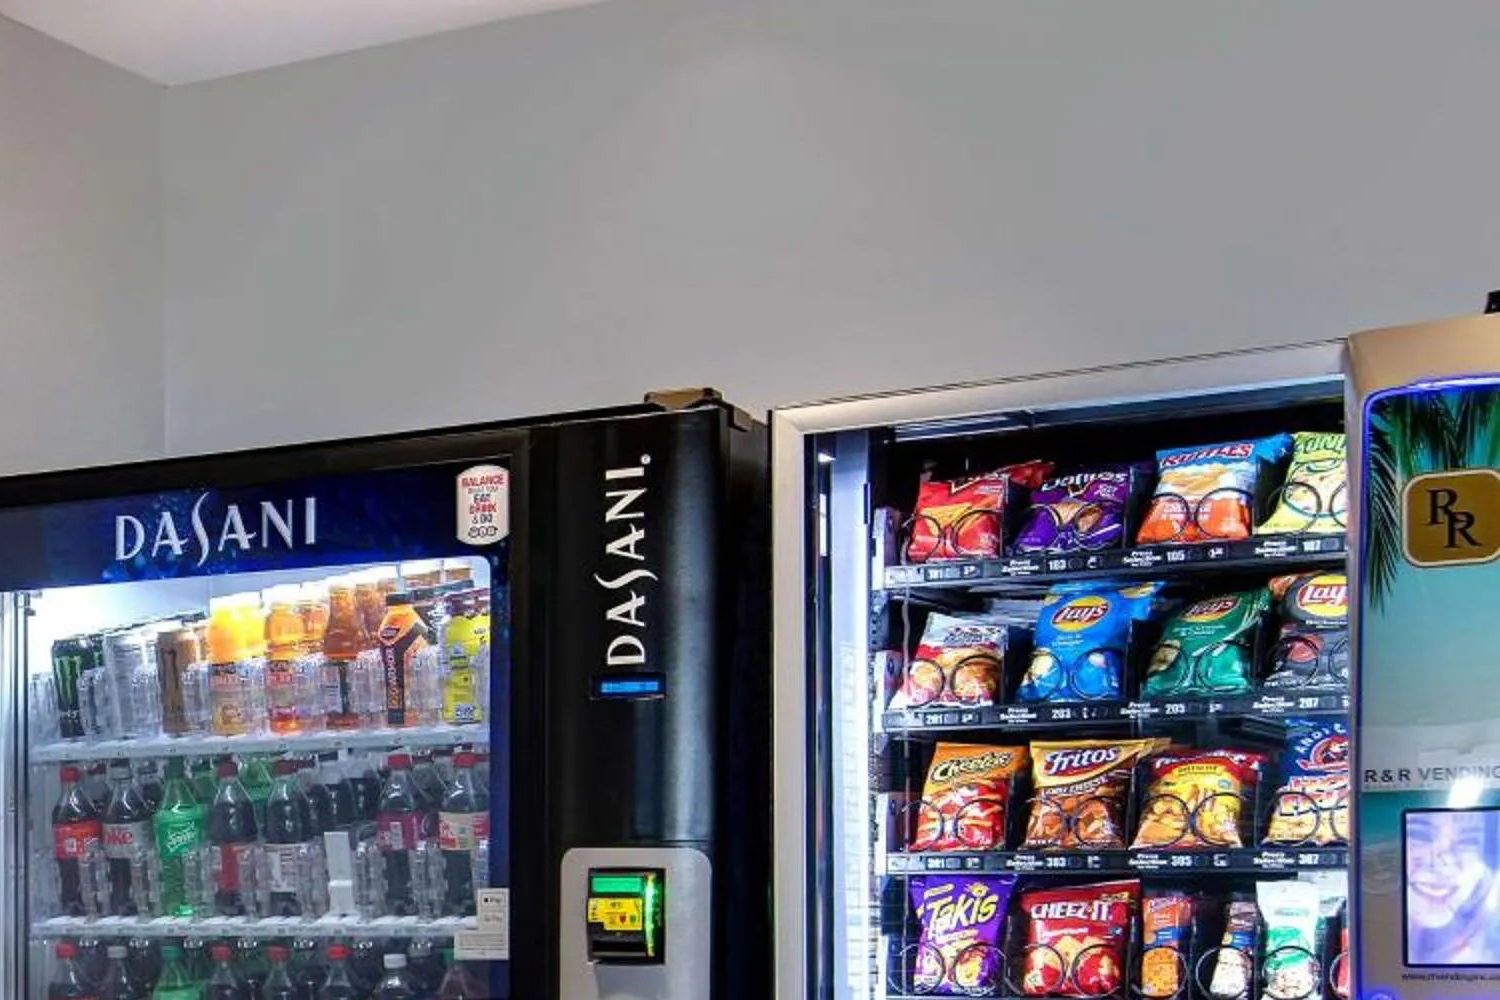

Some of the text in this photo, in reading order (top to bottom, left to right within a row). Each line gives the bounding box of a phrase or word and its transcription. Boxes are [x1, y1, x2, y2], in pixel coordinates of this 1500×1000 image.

[461, 474, 505, 488] BALANCE
[469, 503, 498, 515] DRINK
[115, 491, 317, 568] DASANI
[593, 466, 659, 666] DASANI
[1301, 586, 1348, 604] Lay
[1046, 747, 1119, 774] Fritos
[927, 893, 1000, 941] Takis
